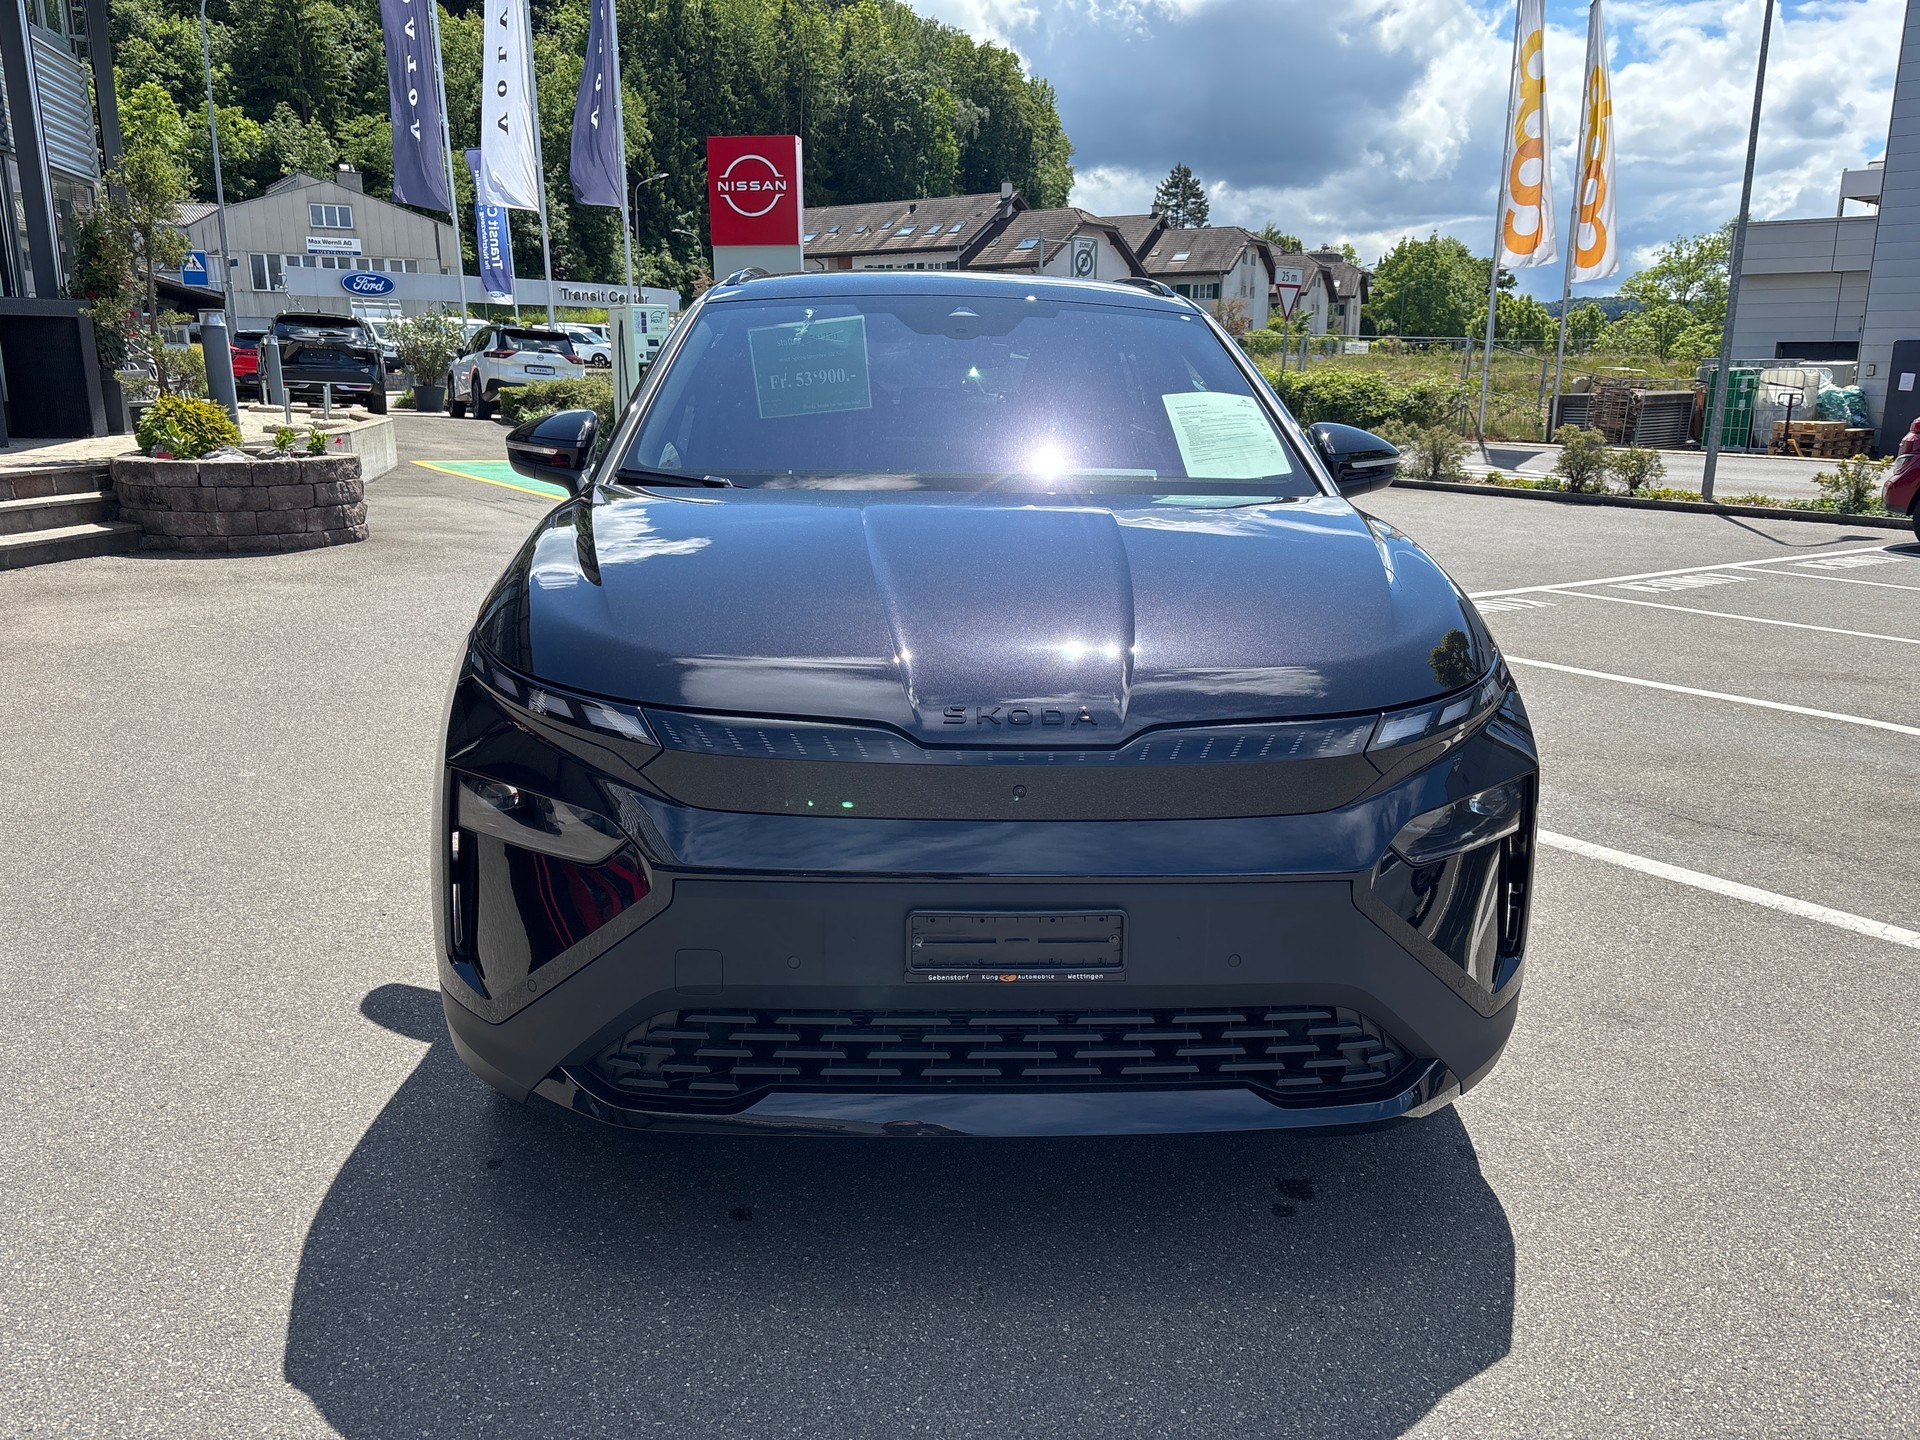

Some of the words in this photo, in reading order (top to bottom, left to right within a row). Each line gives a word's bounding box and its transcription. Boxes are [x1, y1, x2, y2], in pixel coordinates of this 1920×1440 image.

[717, 180, 787, 191] NISSAN
[1281, 271, 1290, 281] 25
[1291, 274, 1298, 282] m
[353, 275, 385, 291] Ford
[560, 288, 606, 302] Transit
[769, 375, 792, 390] Fr.
[1067, 973, 1104, 981] Wettingen
